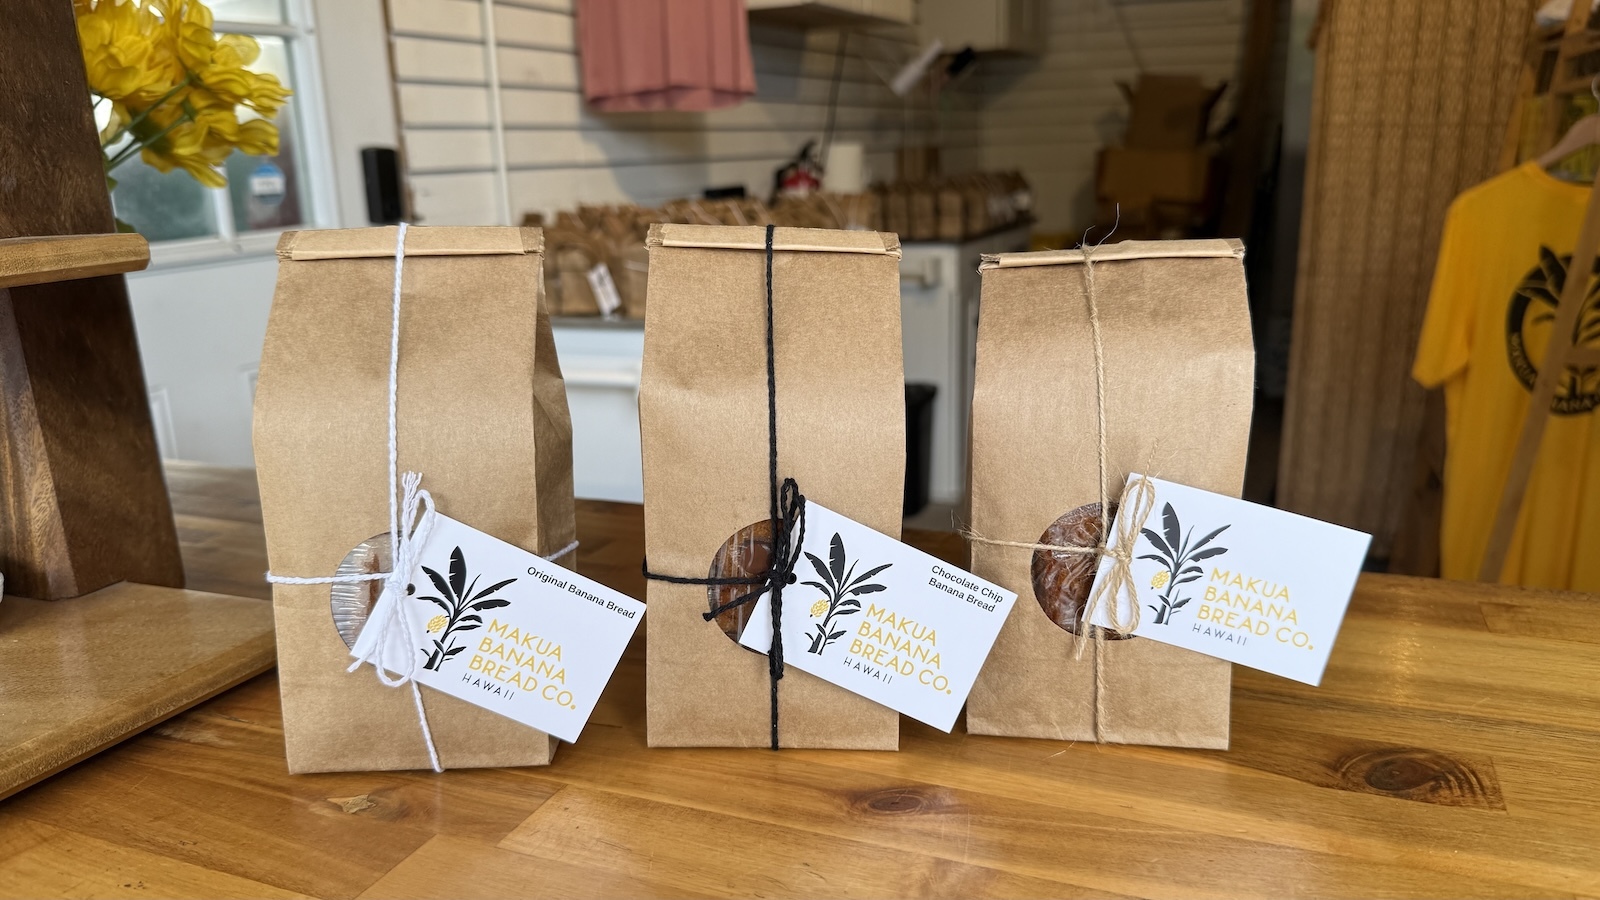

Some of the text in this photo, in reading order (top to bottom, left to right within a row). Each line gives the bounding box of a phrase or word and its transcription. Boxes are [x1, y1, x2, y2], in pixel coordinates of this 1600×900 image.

[527, 566, 636, 619] Original Banana Bread
[928, 577, 995, 612] Banana Bread
[931, 565, 1003, 603] Chocolate Chip
[1210, 568, 1290, 603] MAKUA
[866, 603, 937, 646] MAKUA
[1203, 586, 1298, 625] BANANA
[488, 619, 562, 661] MAKUA
[857, 621, 942, 669] BANANA
[1192, 623, 1247, 646] HAWAII
[1197, 604, 1313, 650] BREAD CO.
[478, 636, 566, 684] BANANA
[843, 657, 893, 684] HAWAII
[849, 639, 952, 695] BREAD CO.
[462, 673, 515, 700] HAWAII
[468, 654, 576, 710] BREAD CO.
